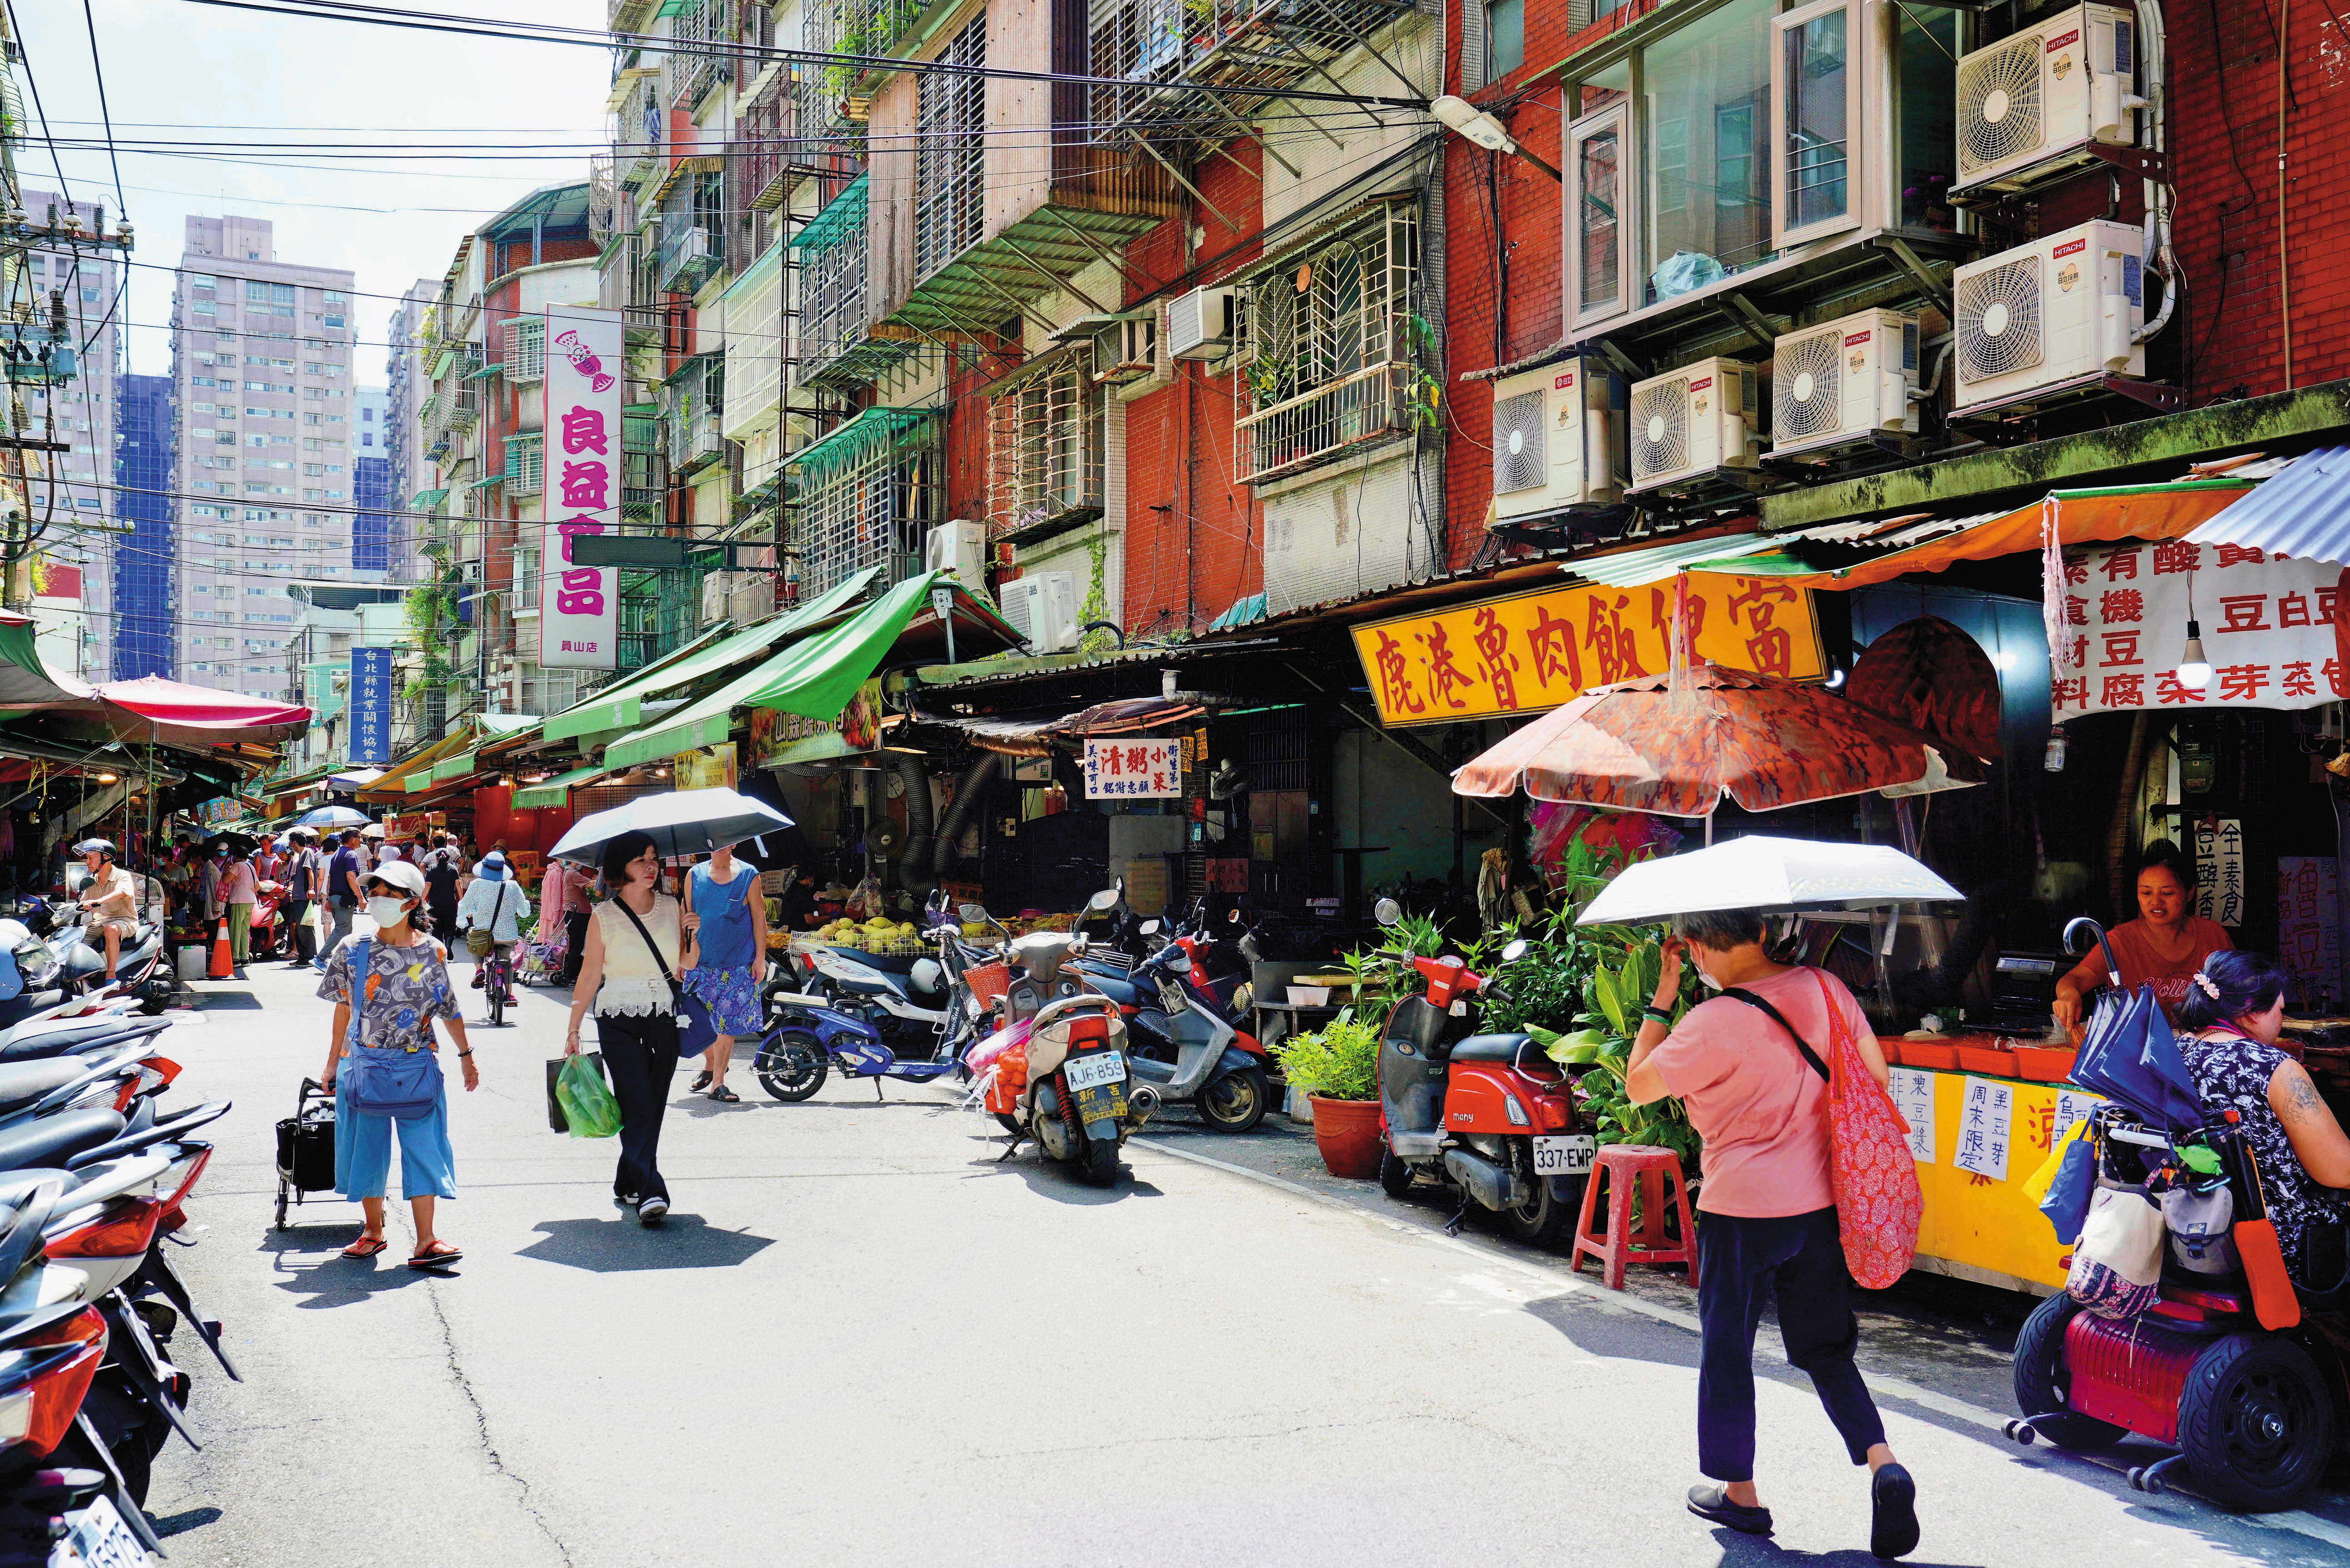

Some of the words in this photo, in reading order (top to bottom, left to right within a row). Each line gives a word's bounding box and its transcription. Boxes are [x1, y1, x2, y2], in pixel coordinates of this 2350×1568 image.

[2048, 32, 2077, 50] HITACHI
[2055, 241, 2084, 256] HITACHI
[1846, 333, 1869, 344] HITACHI
[573, 347, 595, 372] CANDY
[1563, 377, 1572, 385] 日立
[1692, 380, 1711, 390] HITACHI
[2099, 546, 2144, 708] 有機豆腐
[2275, 553, 2316, 697] 白菜
[561, 640, 597, 653] 員山店
[362, 650, 378, 760] 台北縣就業關懷協會
[1087, 744, 1099, 794] 美味可口
[2219, 823, 2244, 925] 全素食
[1453, 1113, 1473, 1123] many
[1961, 1086, 1986, 1172] 周末限定
[1991, 1089, 2008, 1166] 黑豆芽
